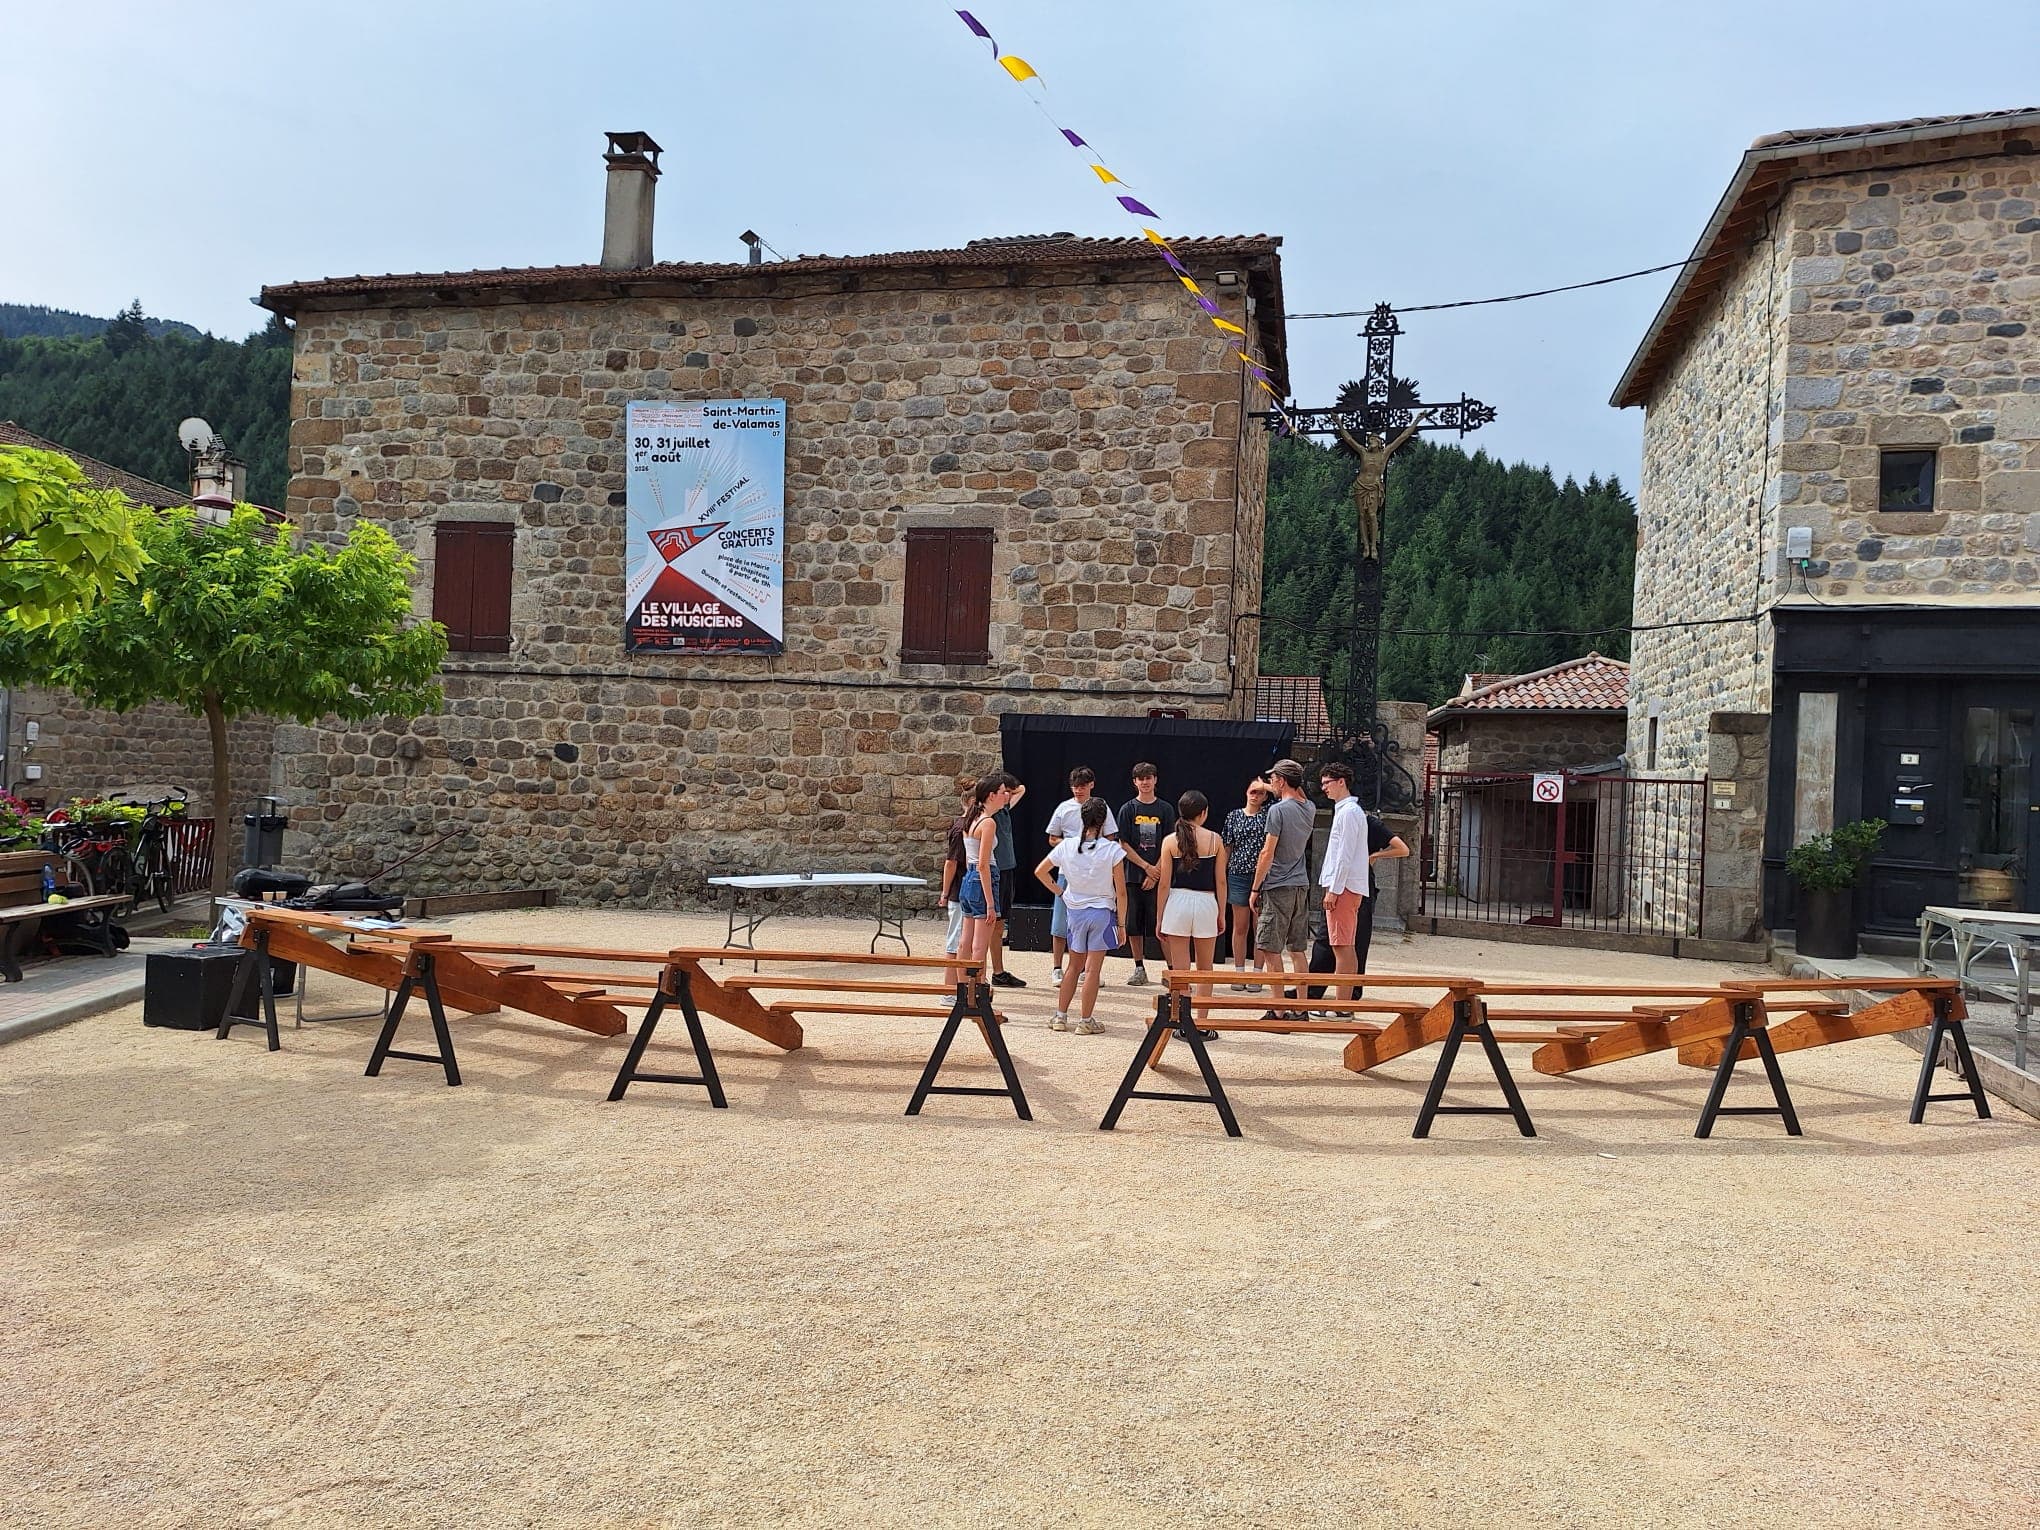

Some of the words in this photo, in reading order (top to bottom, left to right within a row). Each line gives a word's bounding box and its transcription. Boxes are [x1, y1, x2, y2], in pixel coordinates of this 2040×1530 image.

[703, 406, 780, 417] Saint-Martin-
[713, 420, 780, 429] de-Valamas
[634, 437, 653, 450] 30,
[656, 438, 670, 448] 31
[672, 437, 710, 450] juillet
[652, 451, 681, 462] août
[717, 476, 750, 507] FESTIVAL
[718, 528, 775, 540] CONCERTS
[721, 537, 773, 550] GRATUITS
[751, 562, 770, 571] Mairie
[734, 570, 751, 580] partir
[741, 566, 770, 580] chapiteau
[727, 588, 758, 612] restauration
[641, 602, 660, 614] LE
[662, 602, 720, 614] VILLAGE
[641, 615, 668, 627] DES
[672, 616, 743, 628] MUSICIENS
